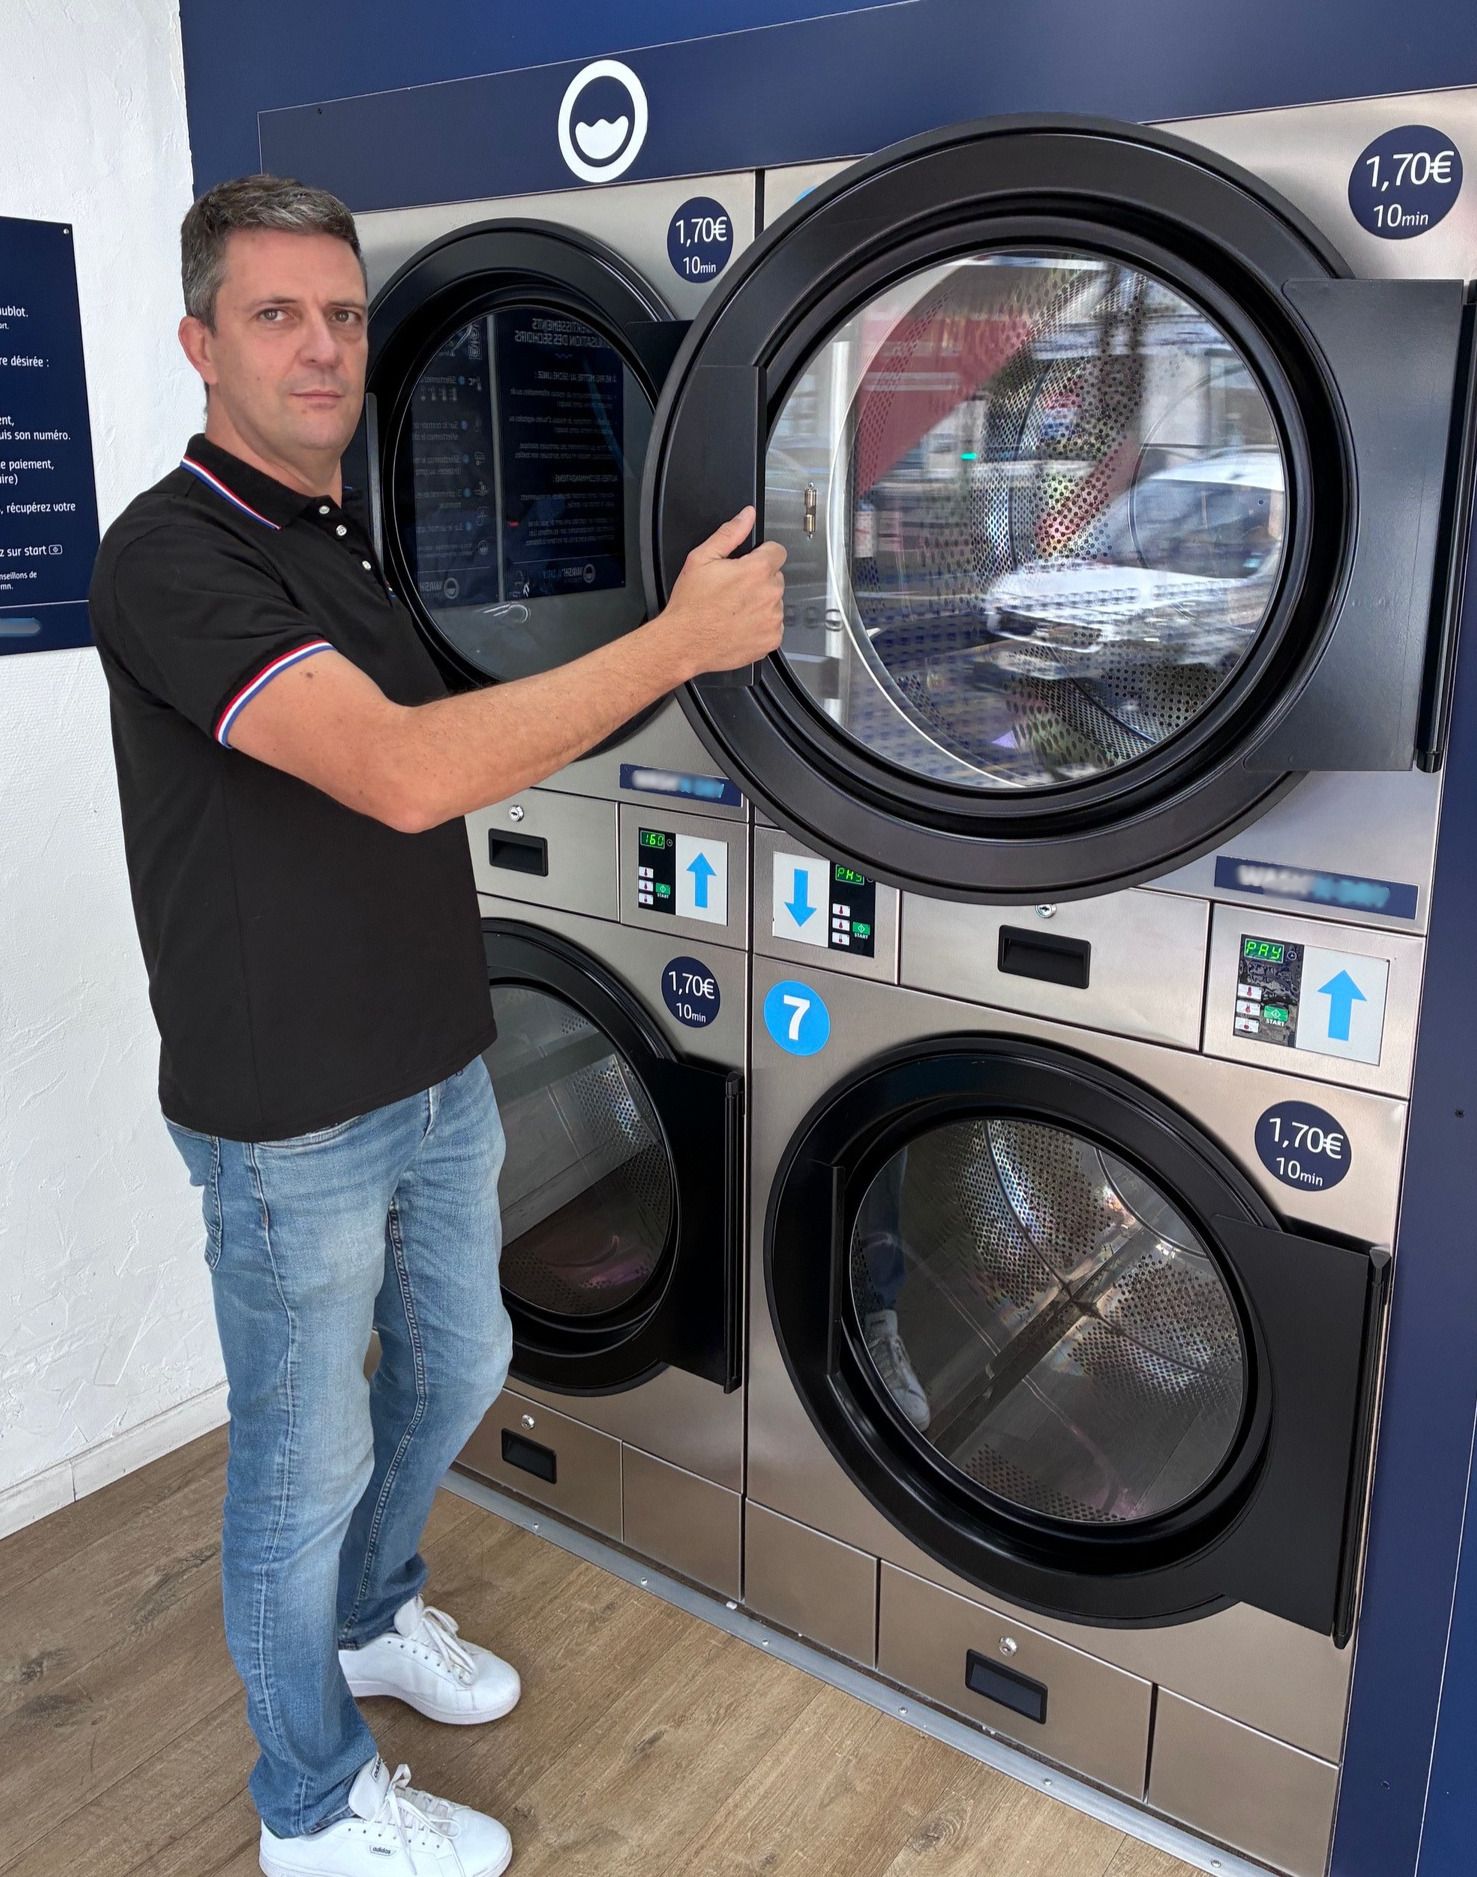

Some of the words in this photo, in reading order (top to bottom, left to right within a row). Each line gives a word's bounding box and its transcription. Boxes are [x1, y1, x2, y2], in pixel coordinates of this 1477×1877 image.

[1366, 150, 1455, 192] 1,70€
[1373, 203, 1429, 228] 10min
[675, 216, 728, 248] 1,70€
[682, 255, 717, 275] 10min
[0, 305, 29, 318] ublot.
[10, 354, 44, 368] désirée
[14, 431, 31, 440] son
[33, 429, 71, 440] numéro.
[8, 458, 55, 472] paiement,
[6, 501, 51, 515] récupérez
[53, 502, 76, 512] votre
[6, 547, 22, 557] sur
[24, 545, 47, 556] start
[28, 570, 38, 579] de
[1245, 941, 1282, 960] PAY
[668, 970, 716, 1000] 1,70€
[675, 1002, 708, 1024] 10min
[783, 994, 811, 1041] 7
[1265, 1018, 1286, 1027] START
[1269, 1117, 1345, 1160] 1,70€
[1275, 1156, 1325, 1187] 10min
[372, 1846, 391, 1855] adidas
